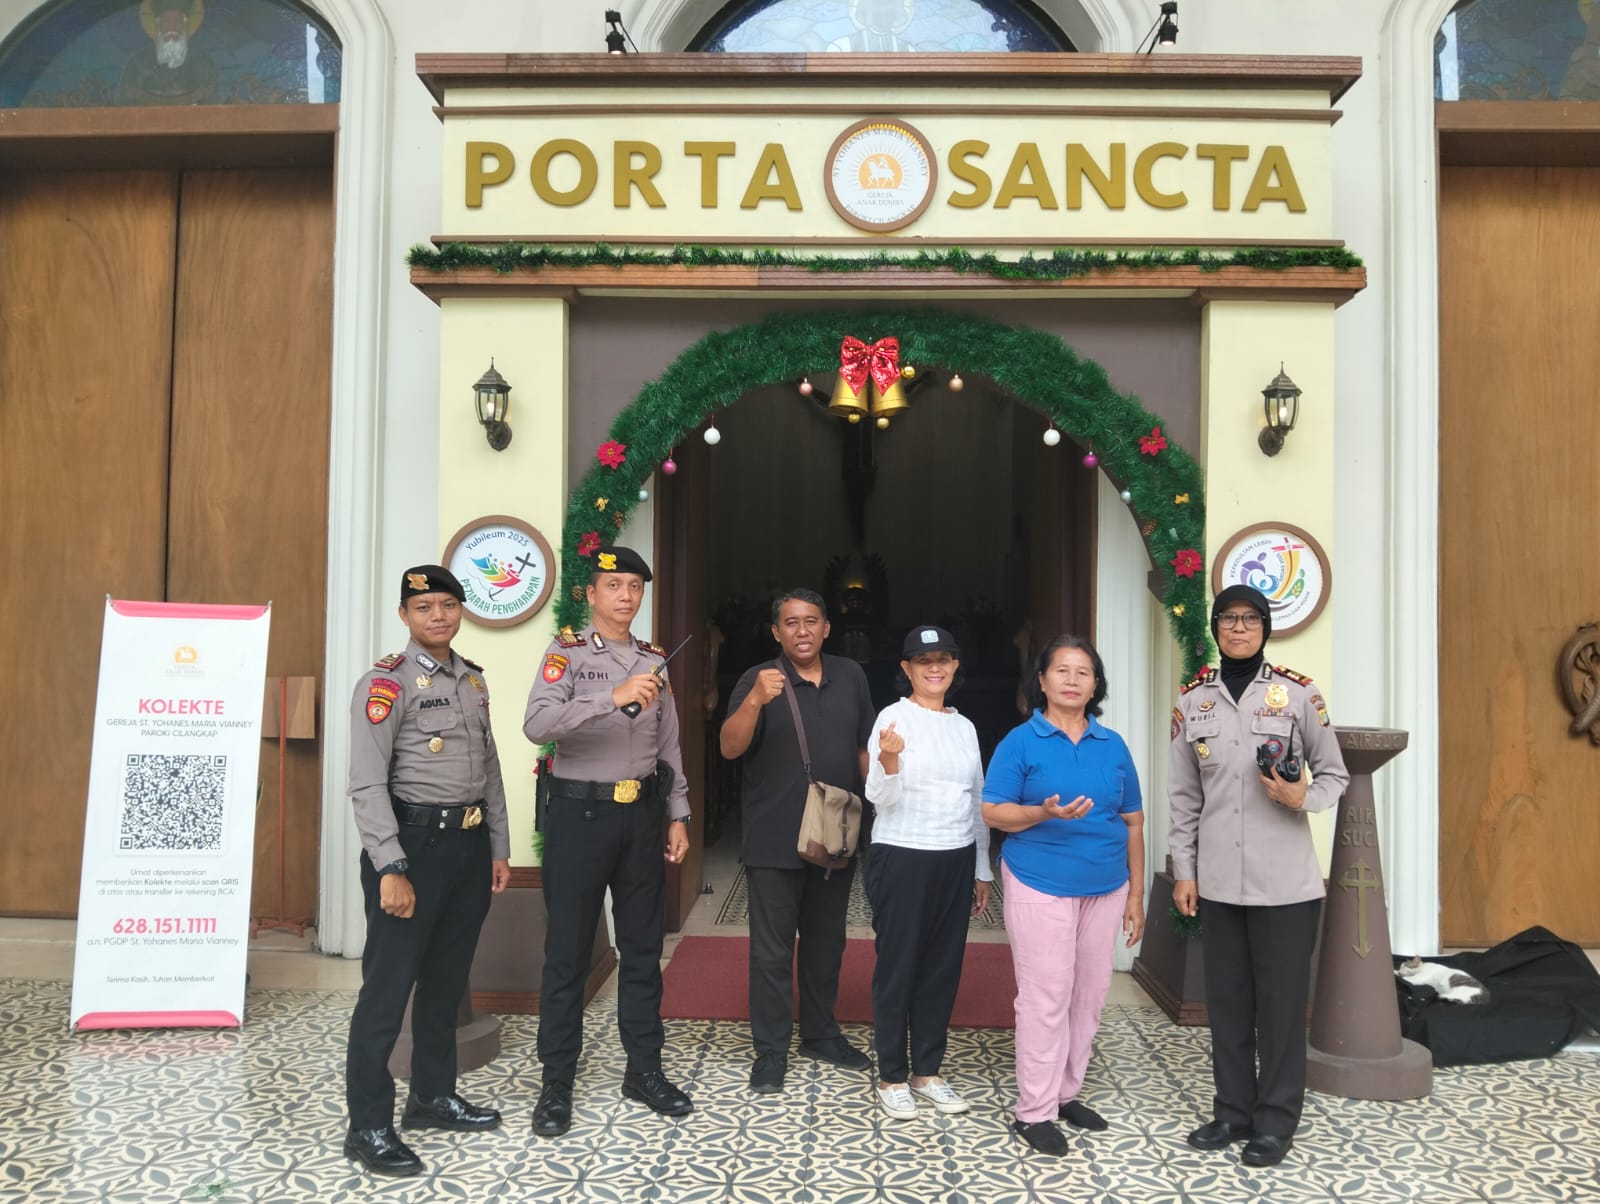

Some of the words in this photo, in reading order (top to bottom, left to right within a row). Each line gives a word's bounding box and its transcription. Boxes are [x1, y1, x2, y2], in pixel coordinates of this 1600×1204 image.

[873, 128, 904, 140] MARIA
[904, 138, 928, 177] VIANNEY
[465, 138, 803, 210] PORTA
[947, 139, 1307, 213] SANCTA
[466, 531, 506, 551] Yubileum
[508, 531, 529, 547] 2025
[492, 576, 541, 615] PENGHARAPAN
[578, 671, 609, 680] ADHI
[138, 698, 224, 715] KOLEKTE
[106, 718, 137, 726] GEREJA
[139, 718, 150, 727] ST.
[152, 719, 190, 728] YOHANES
[191, 720, 216, 728] MARIA
[218, 720, 253, 728] VIANNEY
[140, 729, 170, 737] PAROKI
[172, 730, 218, 738] CILANGKAP
[1346, 733, 1371, 749] AIR
[1344, 806, 1374, 824] AIR
[152, 868, 206, 878] diperkenankan
[185, 888, 216, 897] rekening
[218, 888, 234, 896] BCA
[112, 918, 217, 934] 628.151.1111
[104, 937, 128, 946] PGDP
[130, 938, 140, 946] St.
[143, 938, 177, 946] Yohanes
[179, 937, 204, 945] Maria
[206, 936, 240, 946] Vianney
